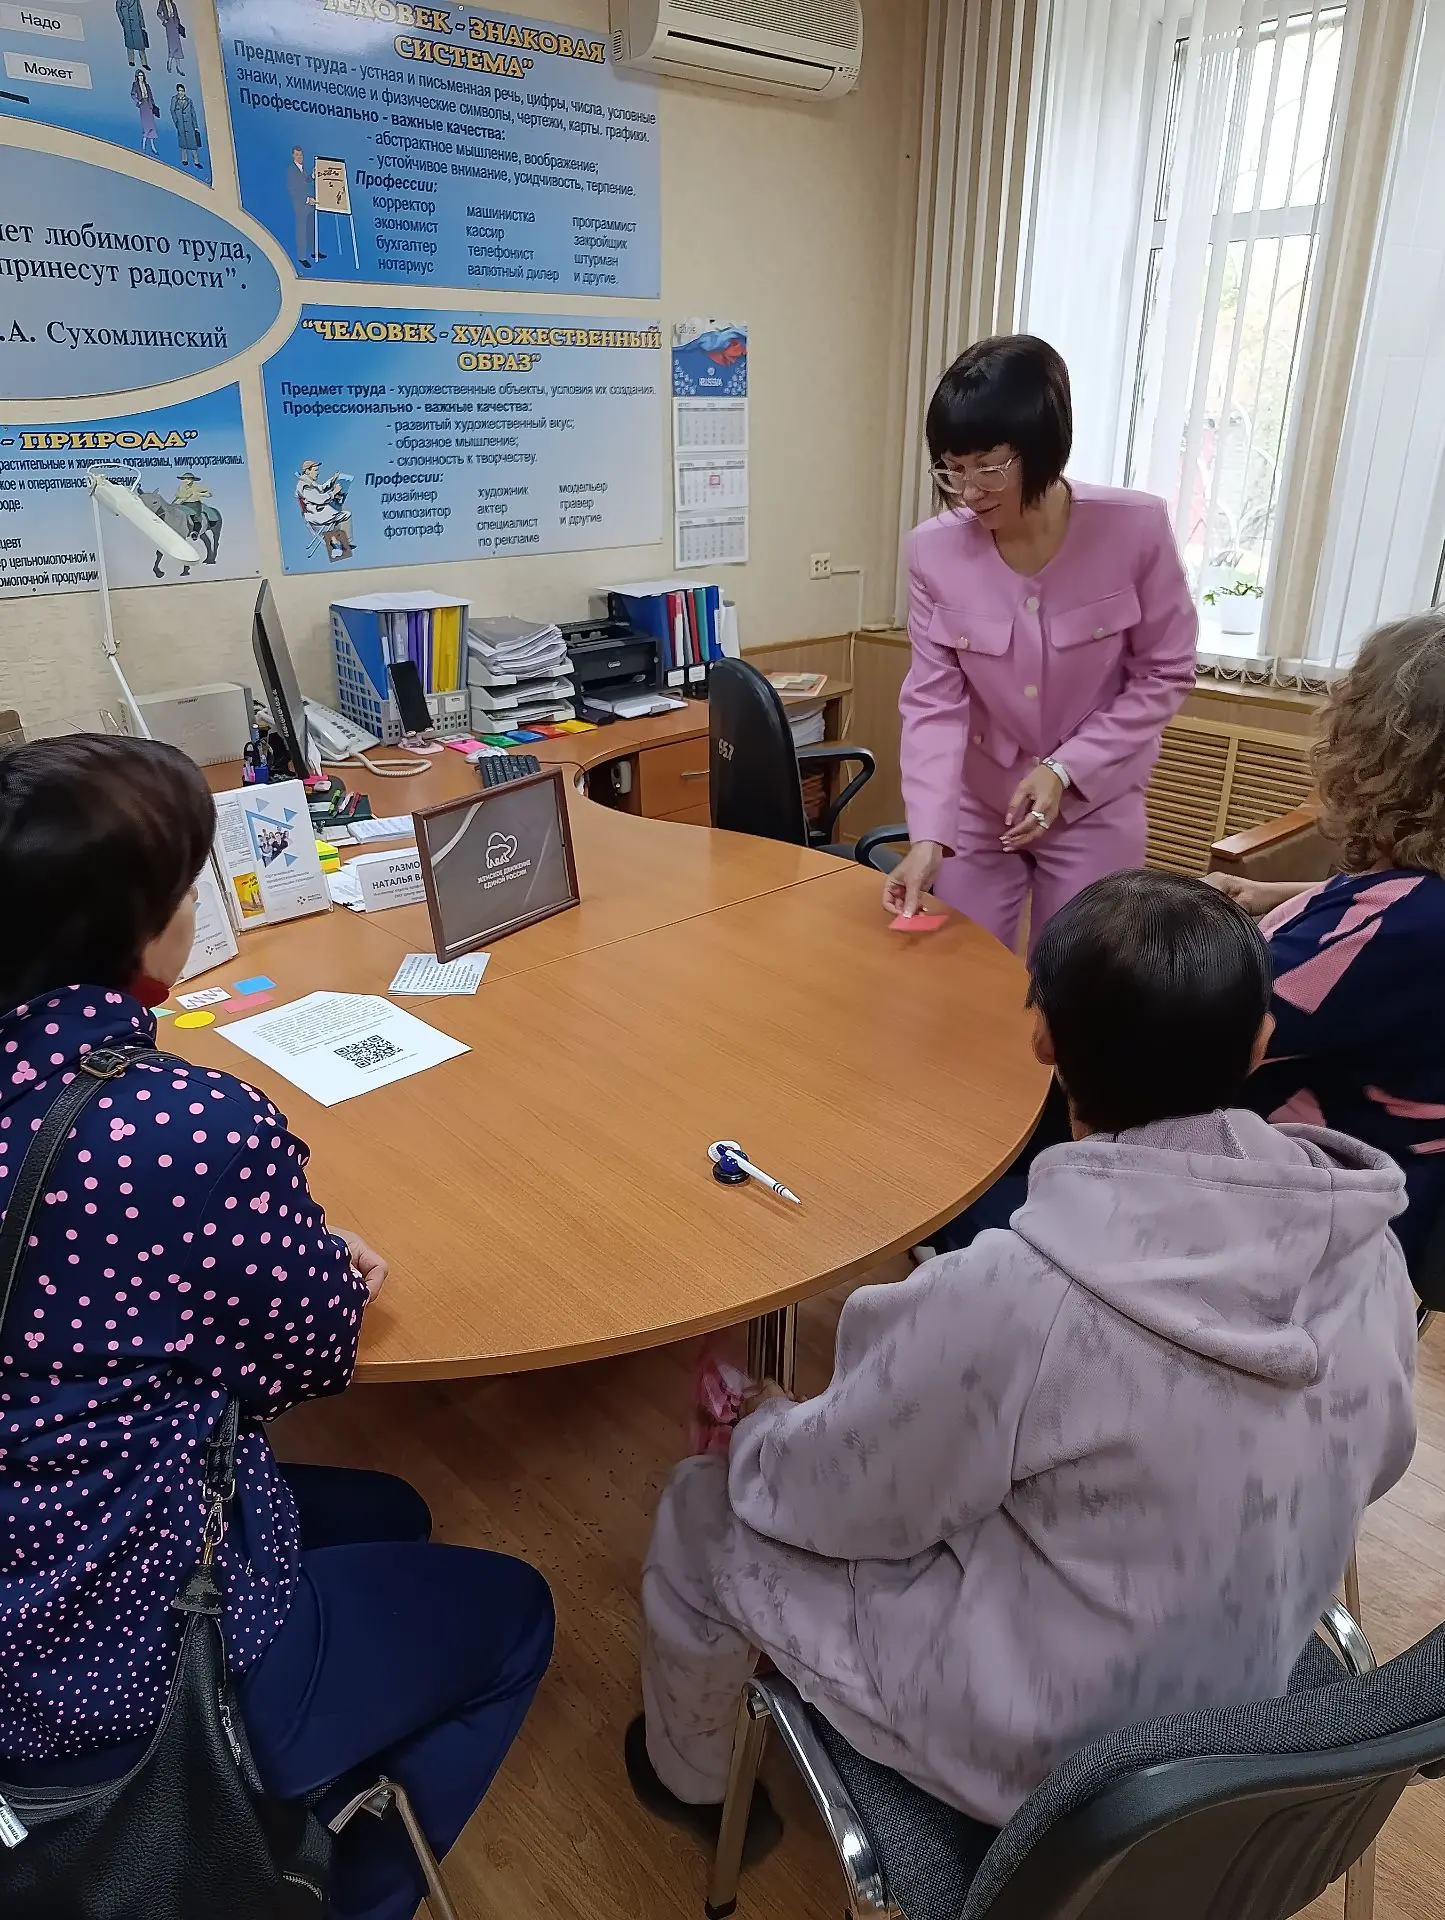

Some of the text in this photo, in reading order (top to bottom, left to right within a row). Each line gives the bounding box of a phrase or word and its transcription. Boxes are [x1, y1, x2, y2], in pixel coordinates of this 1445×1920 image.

[21, 12, 61, 30] Надо
[469, 16, 605, 64] ЗНАКОВАЯ
[24, 62, 73, 80] Может
[234, 40, 301, 66] Предмет
[305, 55, 348, 75] труда
[360, 64, 404, 82] устная
[407, 73, 416, 85] и
[418, 74, 491, 97] письменная
[494, 87, 524, 105] речь,
[526, 92, 569, 112] цифры,
[571, 100, 605, 118] числа,
[607, 105, 656, 125] условные
[236, 67, 282, 88] знаки,
[285, 74, 366, 100] химические
[370, 88, 379, 101] и
[381, 87, 456, 112] физические
[459, 104, 515, 125] символы,
[516, 111, 567, 131] чертежи,
[605, 125, 650, 142] графики.
[240, 87, 379, 122] Профессионально
[392, 113, 443, 132] важные
[446, 120, 505, 141] качества:
[375, 131, 453, 154] абстрактное
[456, 143, 522, 165] мышление,
[525, 152, 599, 174] воображение;
[355, 170, 438, 193] Профессии:
[377, 153, 448, 174] устойчивое
[451, 163, 512, 183] внимание,
[514, 170, 584, 192] усидчивость,
[586, 180, 636, 197] терпение.
[372, 195, 436, 214] корректор
[466, 205, 536, 223] машинистка
[374, 216, 439, 234] экономист
[572, 216, 637, 232] программист
[466, 225, 505, 241] кассир
[45, 222, 170, 254] любимого
[179, 238, 252, 264] труда,
[376, 235, 438, 256] бухгалтер
[573, 234, 628, 250] закройщик
[467, 245, 534, 261] телефонист
[574, 253, 618, 267] штурман
[0, 257, 119, 286] принесут
[378, 258, 434, 275] нотариус
[467, 264, 560, 283] валютный дилер
[573, 272, 619, 286] и другие.
[46, 321, 228, 349] Сухомлинский
[302, 319, 437, 343] “ЧЕЛОВЕК
[451, 324, 662, 349] ХУДОЖЕСТВЕННЫЙ
[281, 382, 344, 397] Предмет
[347, 385, 386, 397] труда
[397, 384, 496, 397] художественные
[499, 383, 548, 397] объекты,
[550, 385, 593, 397] условия
[595, 385, 606, 395] их
[283, 401, 413, 417] Профессионально
[425, 402, 473, 413] важные
[477, 402, 532, 412] качества:
[394, 418, 451, 433] развитый
[454, 417, 547, 432] художественный
[549, 418, 575, 431] вкус;
[20, 430, 198, 450] ПРИРОДА”
[396, 436, 451, 450] образное
[455, 435, 519, 448] мышление;
[0, 459, 66, 474] растительные
[68, 459, 75, 469] и
[397, 455, 464, 467] склонность
[467, 455, 473, 464] к
[476, 453, 537, 466] творчеству.
[19, 480, 26, 489] и
[28, 478, 87, 492] оперативное
[365, 472, 444, 488] Профессии:
[559, 481, 608, 494] модельер
[381, 490, 438, 505] дизайнер
[477, 485, 529, 499] художник
[382, 507, 451, 521] композитор
[477, 502, 508, 516] актер
[477, 517, 538, 531] специалист
[560, 515, 567, 525] и
[384, 522, 444, 539] фотограф
[0, 538, 21, 551] цевт
[478, 533, 539, 549] по рекламе
[9, 550, 88, 569] цельномолочной
[89, 552, 96, 562] и
[52, 570, 98, 586] продукции
[372, 874, 413, 889] НАТАЛЬЯ
